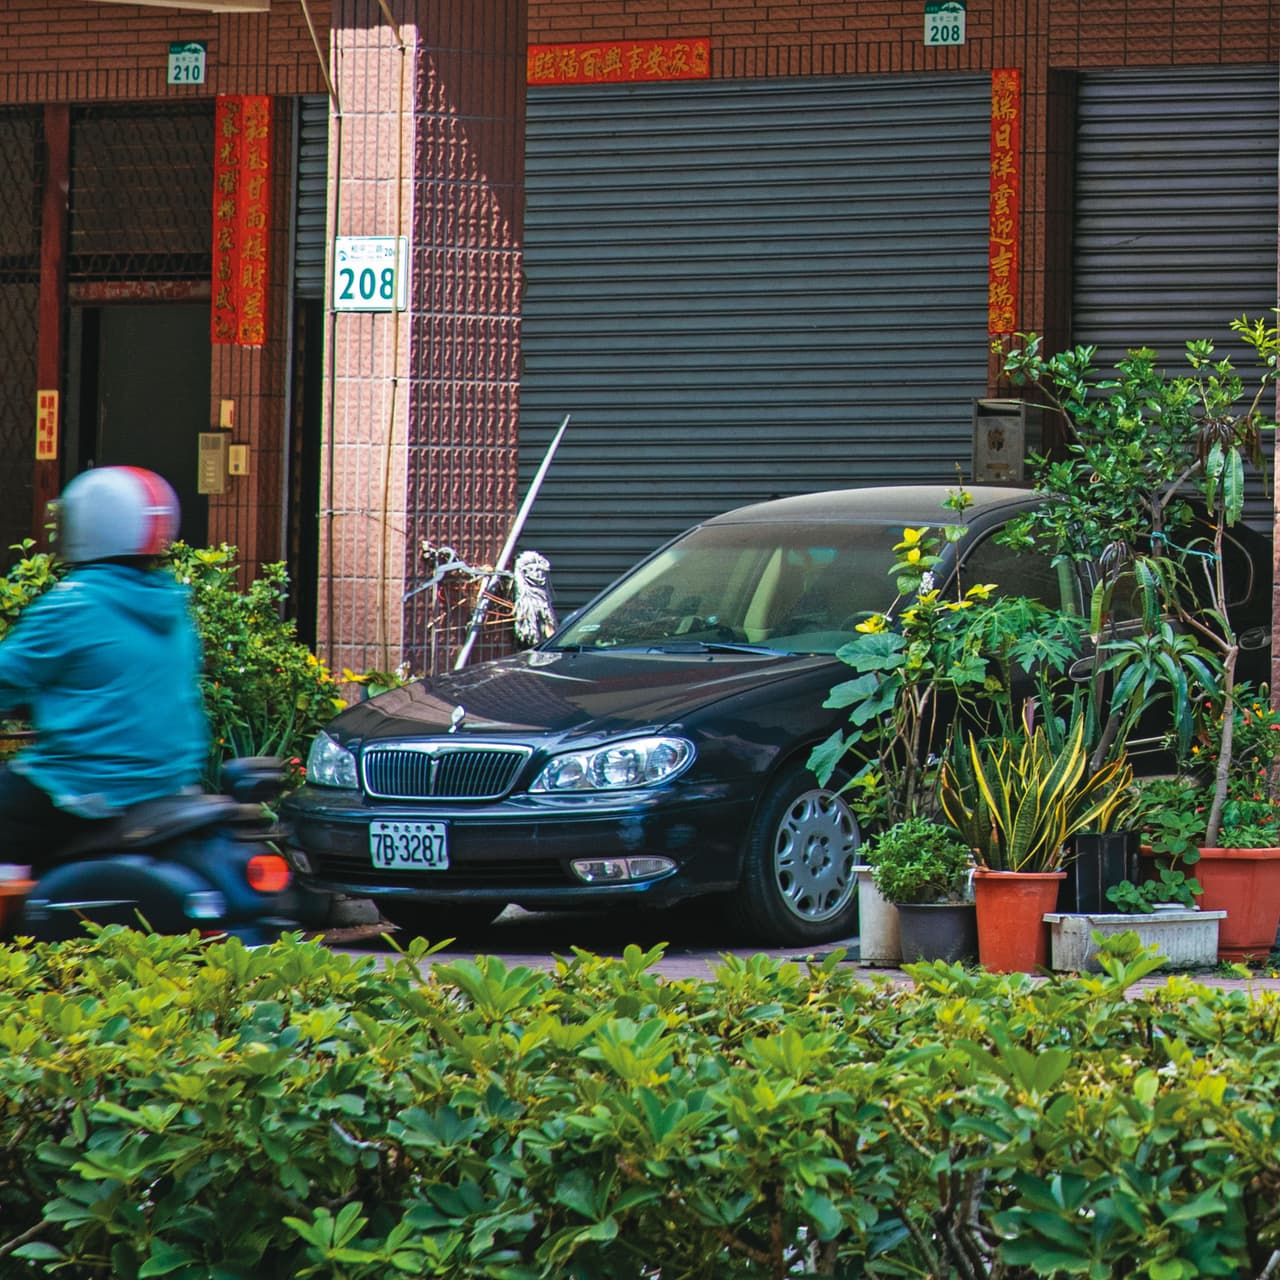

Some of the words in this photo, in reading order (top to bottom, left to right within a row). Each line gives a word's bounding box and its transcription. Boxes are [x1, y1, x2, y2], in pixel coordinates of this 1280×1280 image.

[930, 24, 960, 42] 208
[174, 64, 201, 81] 210
[339, 267, 395, 300] 208
